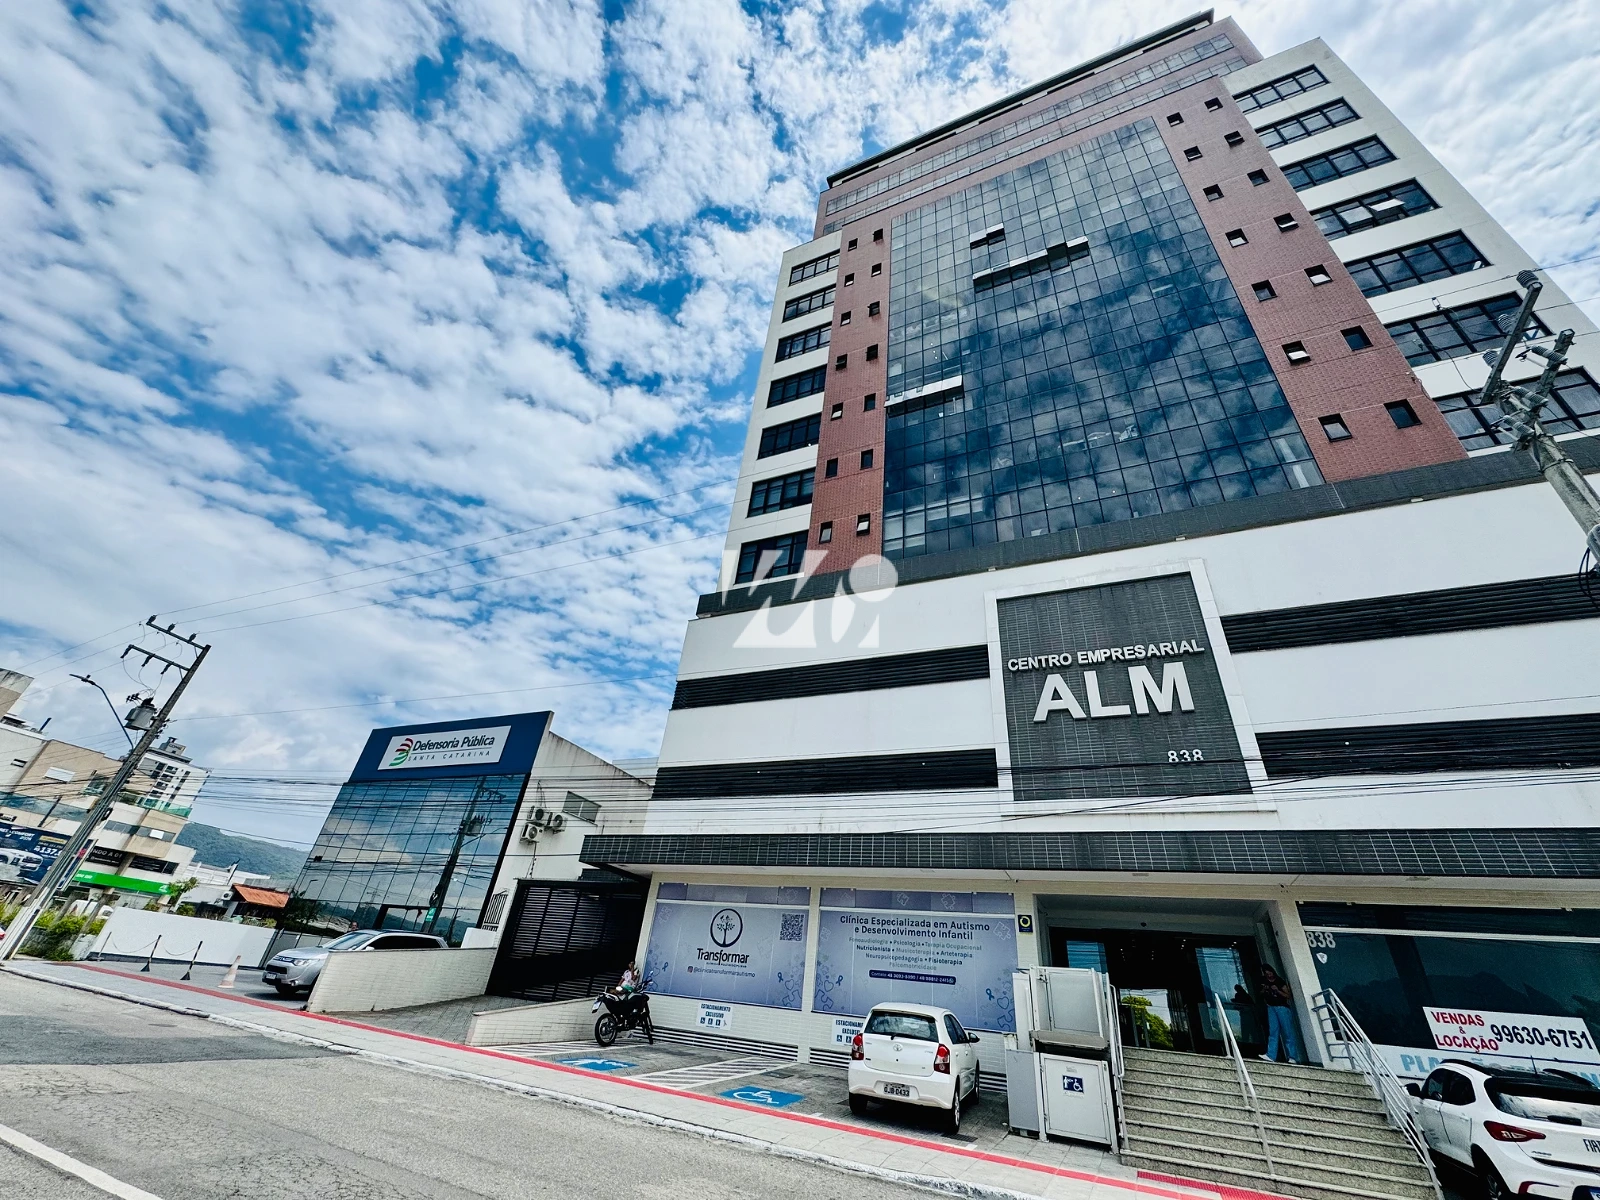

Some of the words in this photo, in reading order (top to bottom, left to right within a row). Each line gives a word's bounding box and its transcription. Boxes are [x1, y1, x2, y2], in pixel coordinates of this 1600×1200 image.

[1007, 652, 1072, 671] CENTRO
[1077, 639, 1204, 665] EMPRESARIAL
[1033, 661, 1195, 723] ALM
[412, 737, 460, 752] Defensoria
[460, 735, 496, 748] Pública
[408, 754, 436, 762] SANTA
[442, 750, 491, 760] CATARINA
[1167, 749, 1204, 763] 838
[840, 914, 869, 925] Clínica
[871, 917, 931, 928] Especializada
[933, 921, 948, 929] em
[950, 920, 990, 931] Autismo
[861, 925, 937, 937] Desenvolvimento
[938, 929, 973, 940] Infantil
[1305, 931, 1336, 948] 838
[848, 937, 888, 945] Fonoaudiologia
[893, 939, 921, 948] Psicologia
[924, 941, 945, 949] Terapia
[946, 943, 982, 951] Ocupacional
[856, 944, 891, 953] Nutricionista
[896, 947, 935, 956] Musicoterapia
[940, 950, 973, 959] Arteterapia
[697, 948, 750, 966] Transformar
[865, 952, 923, 963] Neuropsicopedagogia
[927, 957, 963, 966] Fisioterapia
[1431, 1011, 1485, 1027] VENDAS
[1458, 1026, 1466, 1034] &
[1434, 1033, 1499, 1054] LOCAÇÃO
[1490, 1023, 1593, 1050] 99630-6751
